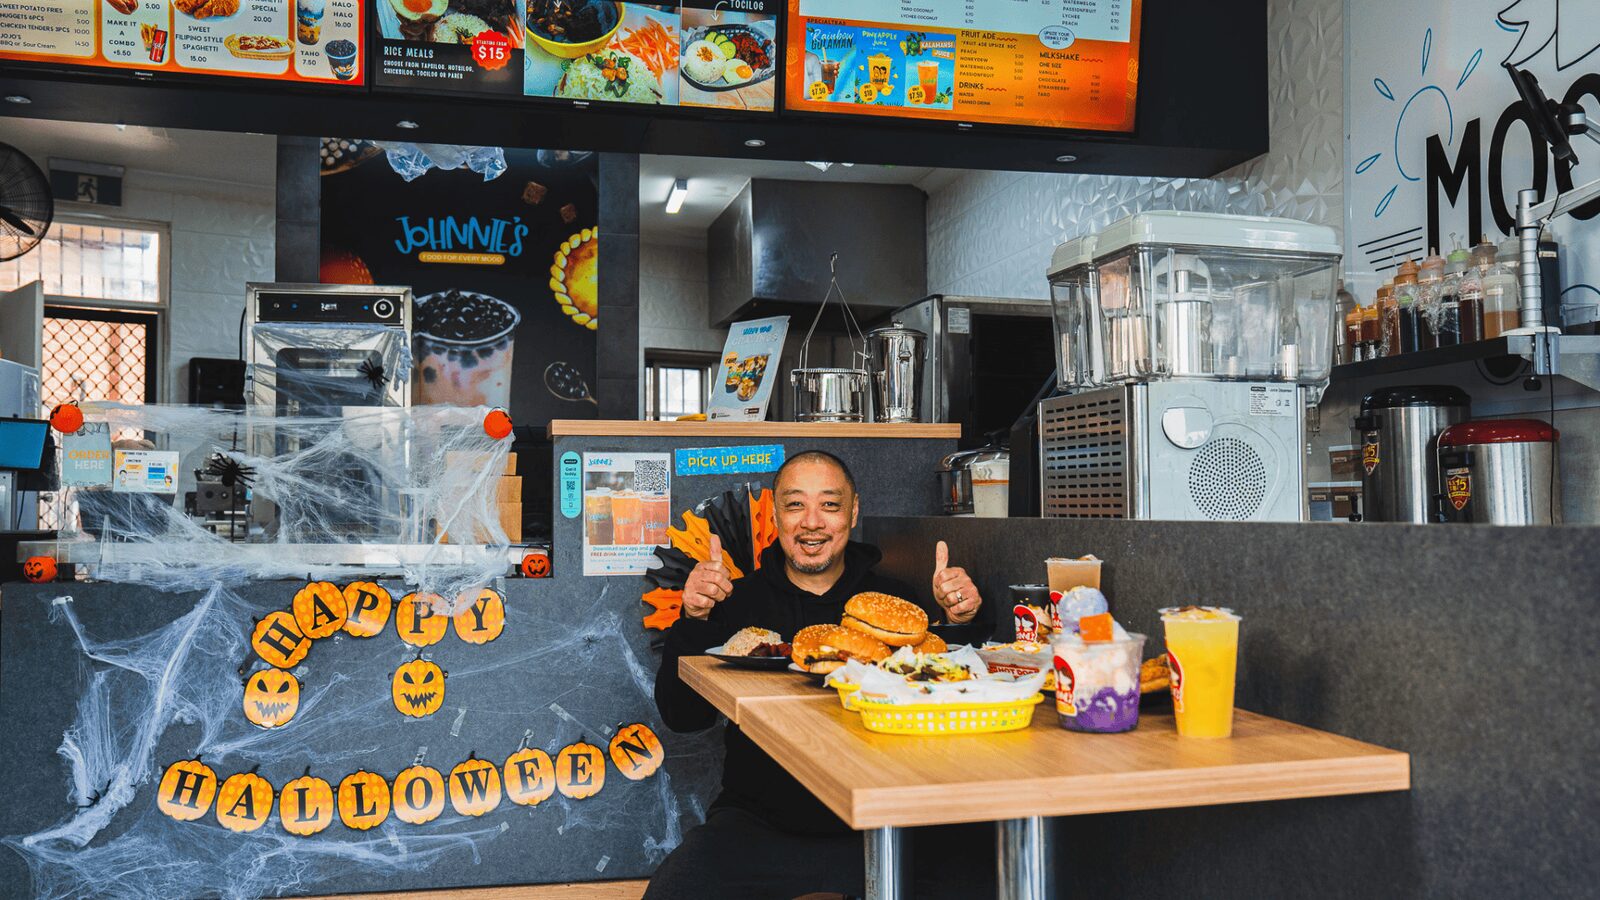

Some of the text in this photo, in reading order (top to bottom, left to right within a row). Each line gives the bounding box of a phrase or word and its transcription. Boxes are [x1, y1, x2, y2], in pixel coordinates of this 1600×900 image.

[730, 0, 764, 10] TOCILOG
[811, 28, 854, 42] Rainbow
[862, 30, 897, 40] PINEAPPLE
[182, 44, 218, 52] SPAGHETTI
[812, 38, 852, 50] GULAMAN
[384, 46, 434, 58] RICE MEALS
[478, 46, 504, 60] $15
[1040, 52, 1080, 61] MILKSHAKE
[394, 216, 528, 256] JOHNNIE'S
[68, 450, 109, 460] ORDER
[688, 454, 772, 468] PICK UP HERE
[75, 460, 104, 470] HERE
[260, 589, 491, 660] HAPPY
[168, 730, 653, 822] HALLOWEEN
